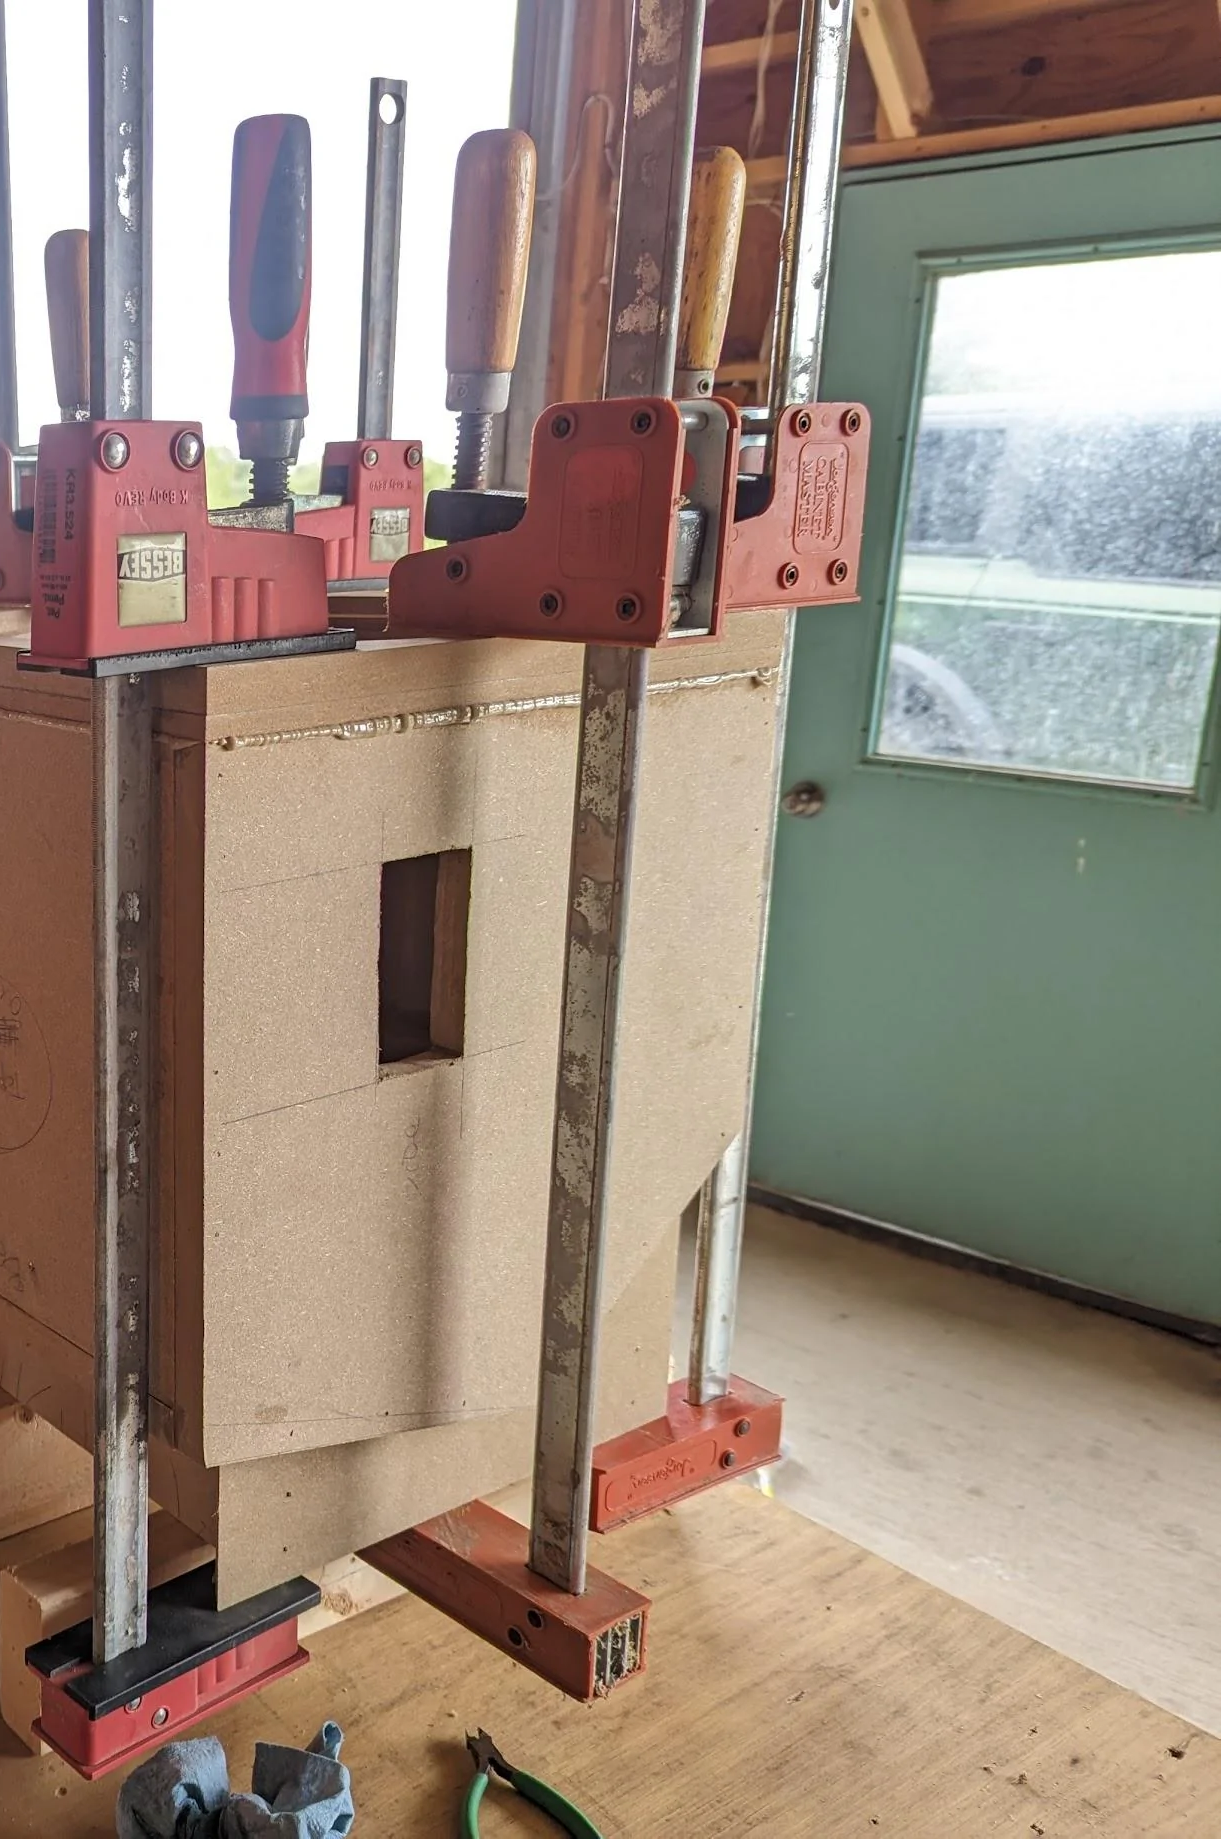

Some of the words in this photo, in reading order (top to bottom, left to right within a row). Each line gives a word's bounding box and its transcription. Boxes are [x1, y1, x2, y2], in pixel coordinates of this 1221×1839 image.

[114, 488, 147, 508] REVO
[148, 487, 177, 506] Body
[179, 488, 190, 506] K
[796, 460, 814, 538] MASTER
[810, 456, 827, 540] CABINET
[119, 548, 184, 579] BESSEY
